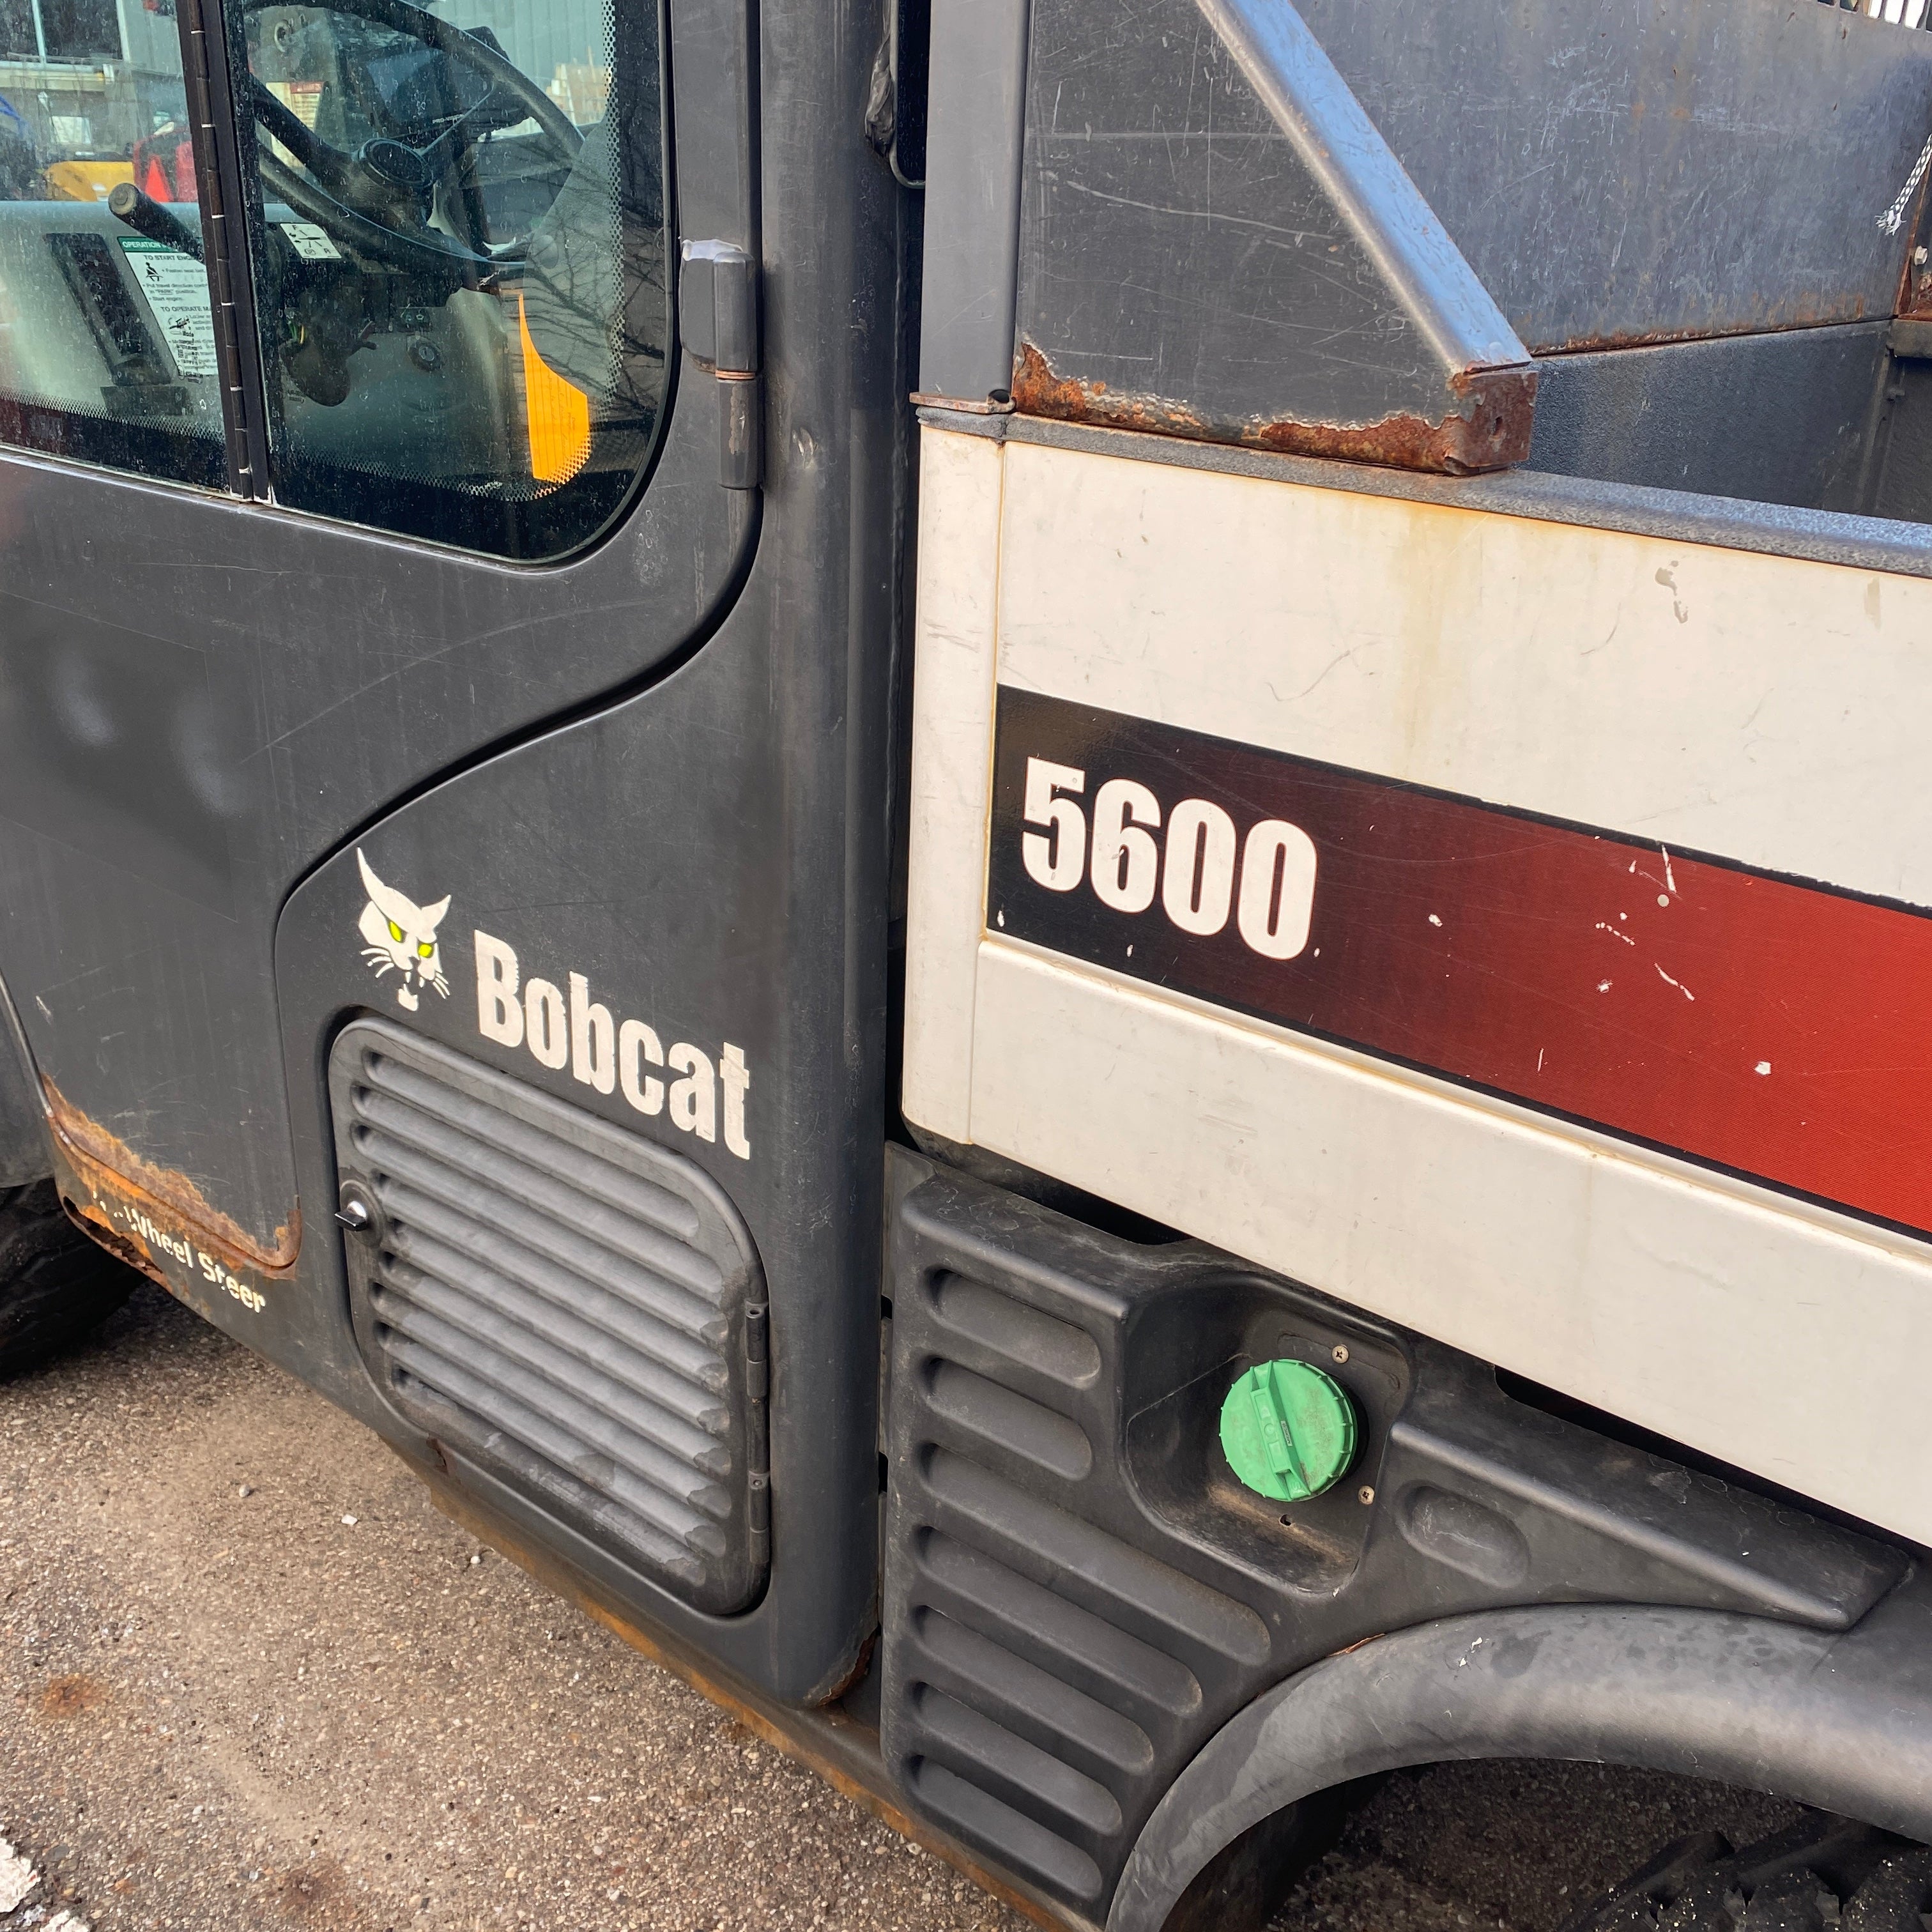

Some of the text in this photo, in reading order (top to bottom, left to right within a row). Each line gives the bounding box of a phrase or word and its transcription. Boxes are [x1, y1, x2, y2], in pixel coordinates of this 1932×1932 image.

[1022, 756, 1317, 960] 5600
[474, 929, 750, 1160] Bobcat
[198, 1251, 266, 1314] Steer
